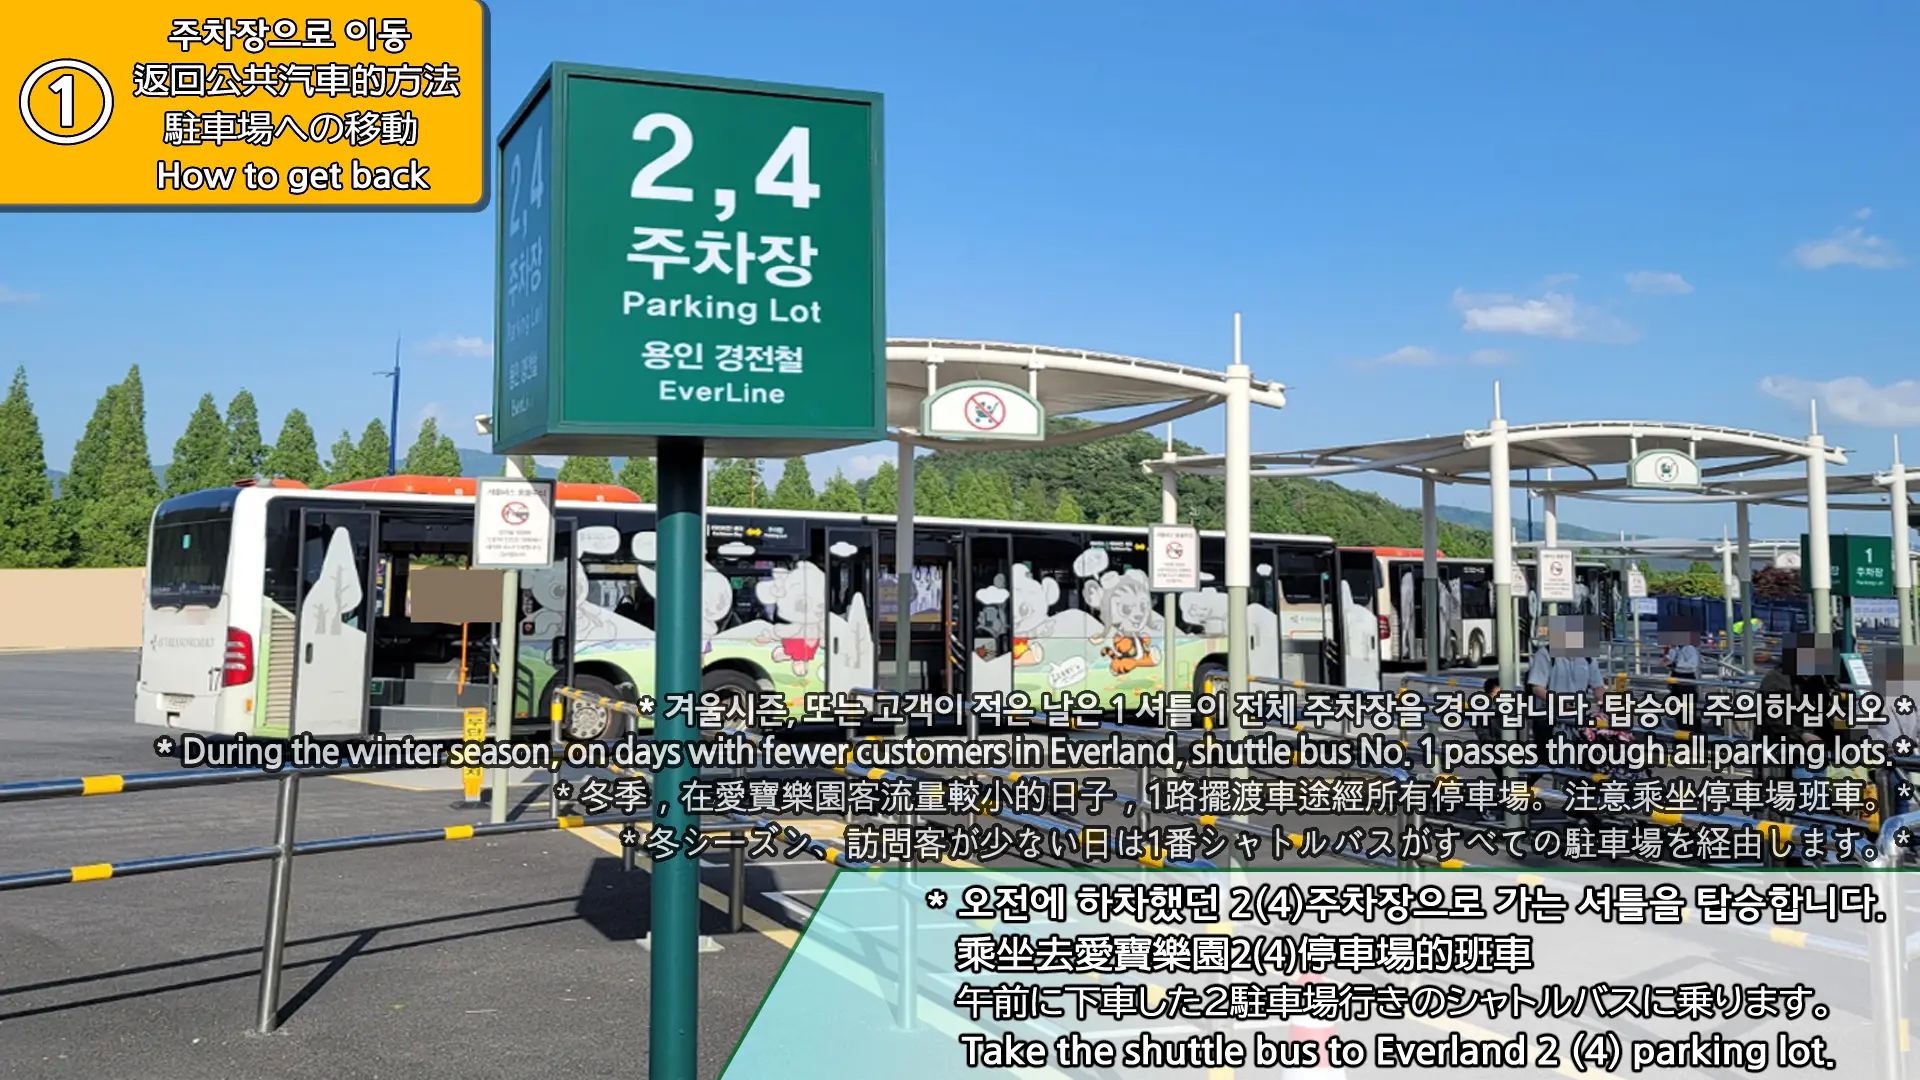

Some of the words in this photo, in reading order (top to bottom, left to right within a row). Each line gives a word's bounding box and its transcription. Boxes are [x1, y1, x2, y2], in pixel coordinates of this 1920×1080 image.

[626, 226, 818, 287] 주차장
[623, 291, 758, 325] Parking
[771, 298, 821, 323] Lot
[641, 341, 703, 370] 용인
[716, 345, 804, 373] 경전철
[659, 381, 785, 404] EverLine
[1865, 547, 1873, 564] 1
